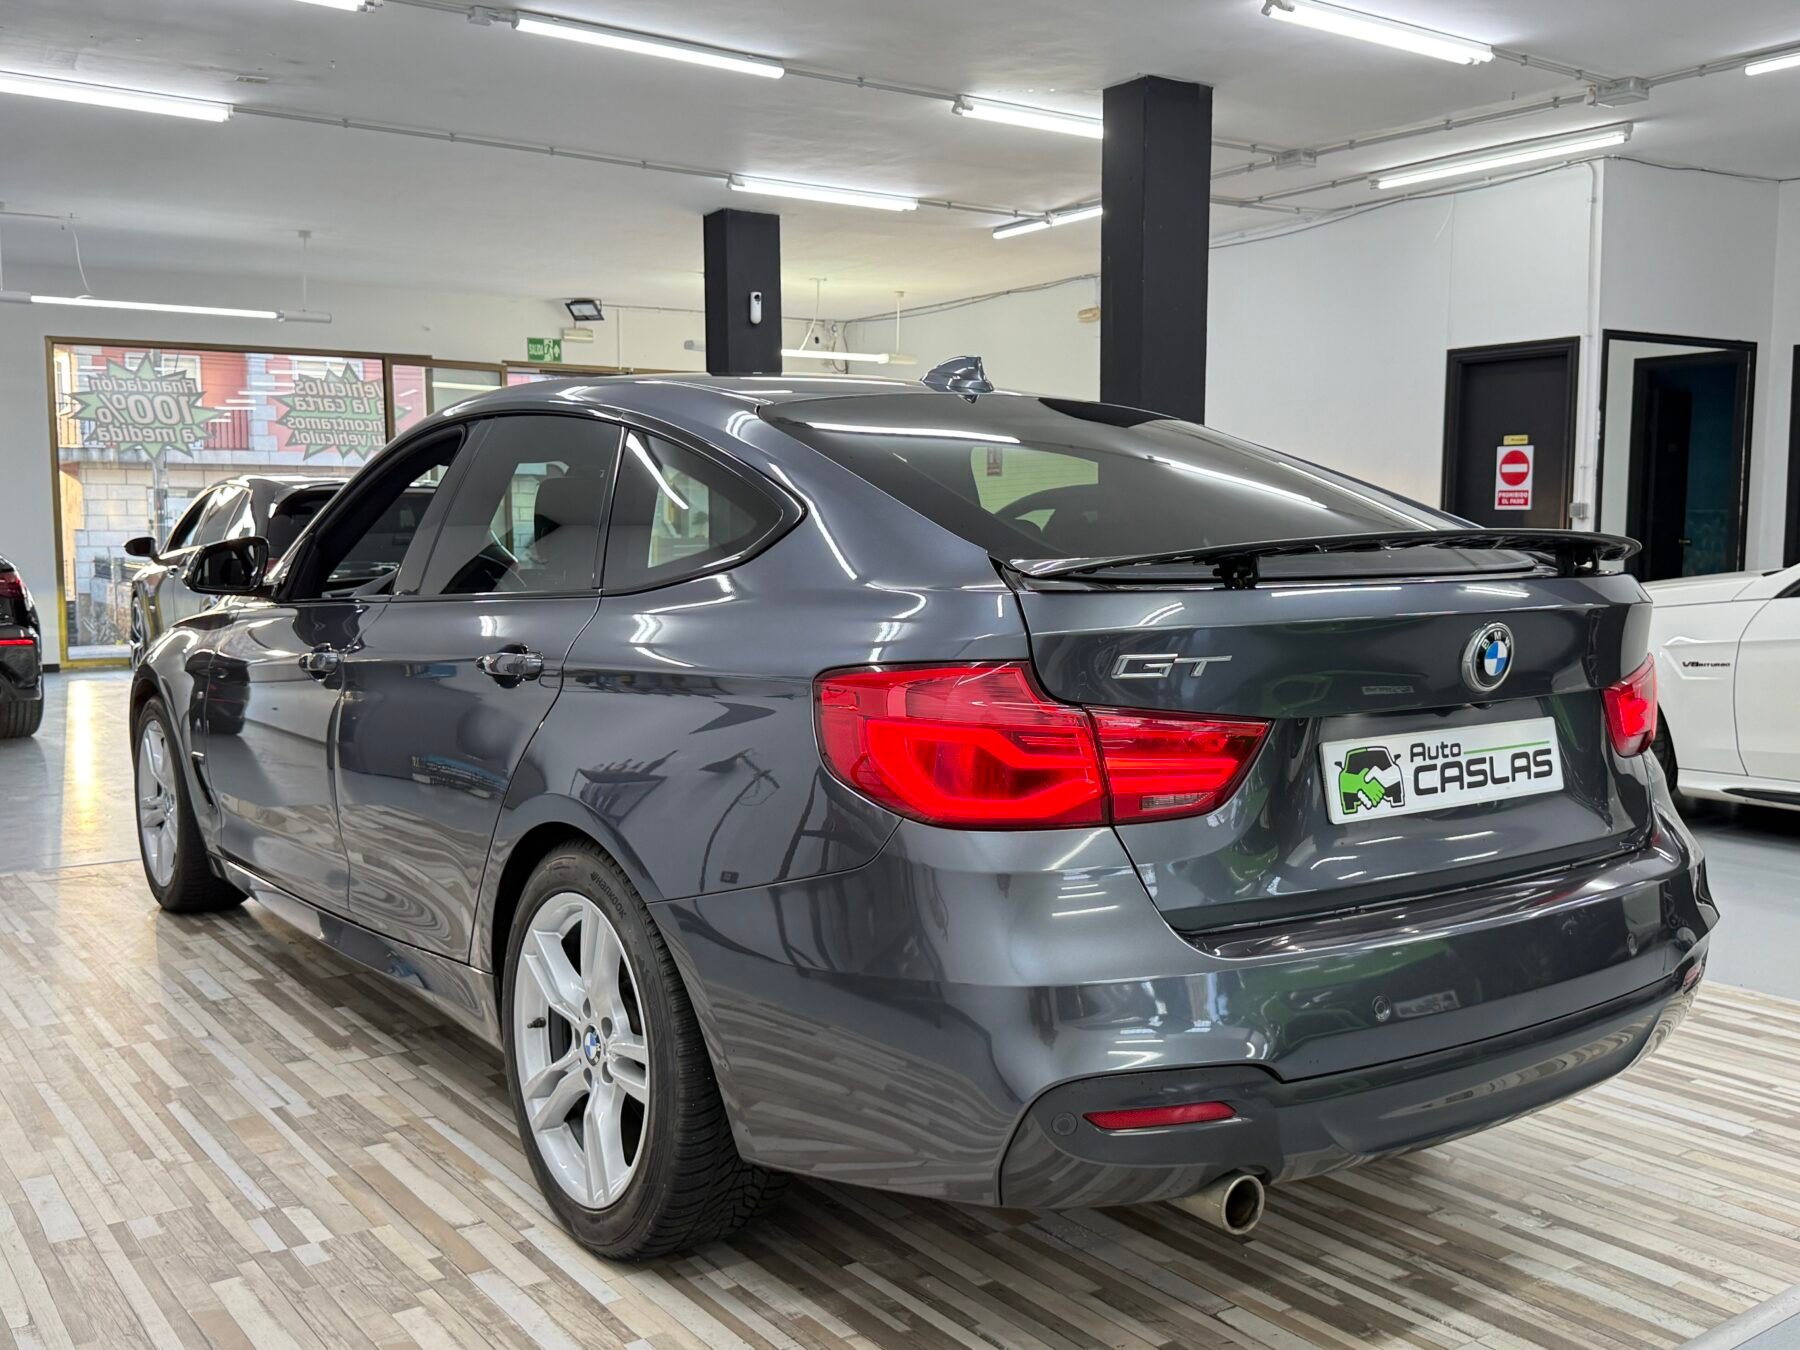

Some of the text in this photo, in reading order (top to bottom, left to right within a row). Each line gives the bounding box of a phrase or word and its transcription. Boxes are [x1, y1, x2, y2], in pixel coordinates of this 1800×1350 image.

[1481, 631, 1511, 650] BMW
[1111, 653, 1232, 680] GT
[1410, 741, 1461, 763] Auto
[1413, 749, 1553, 796] CASLAS
